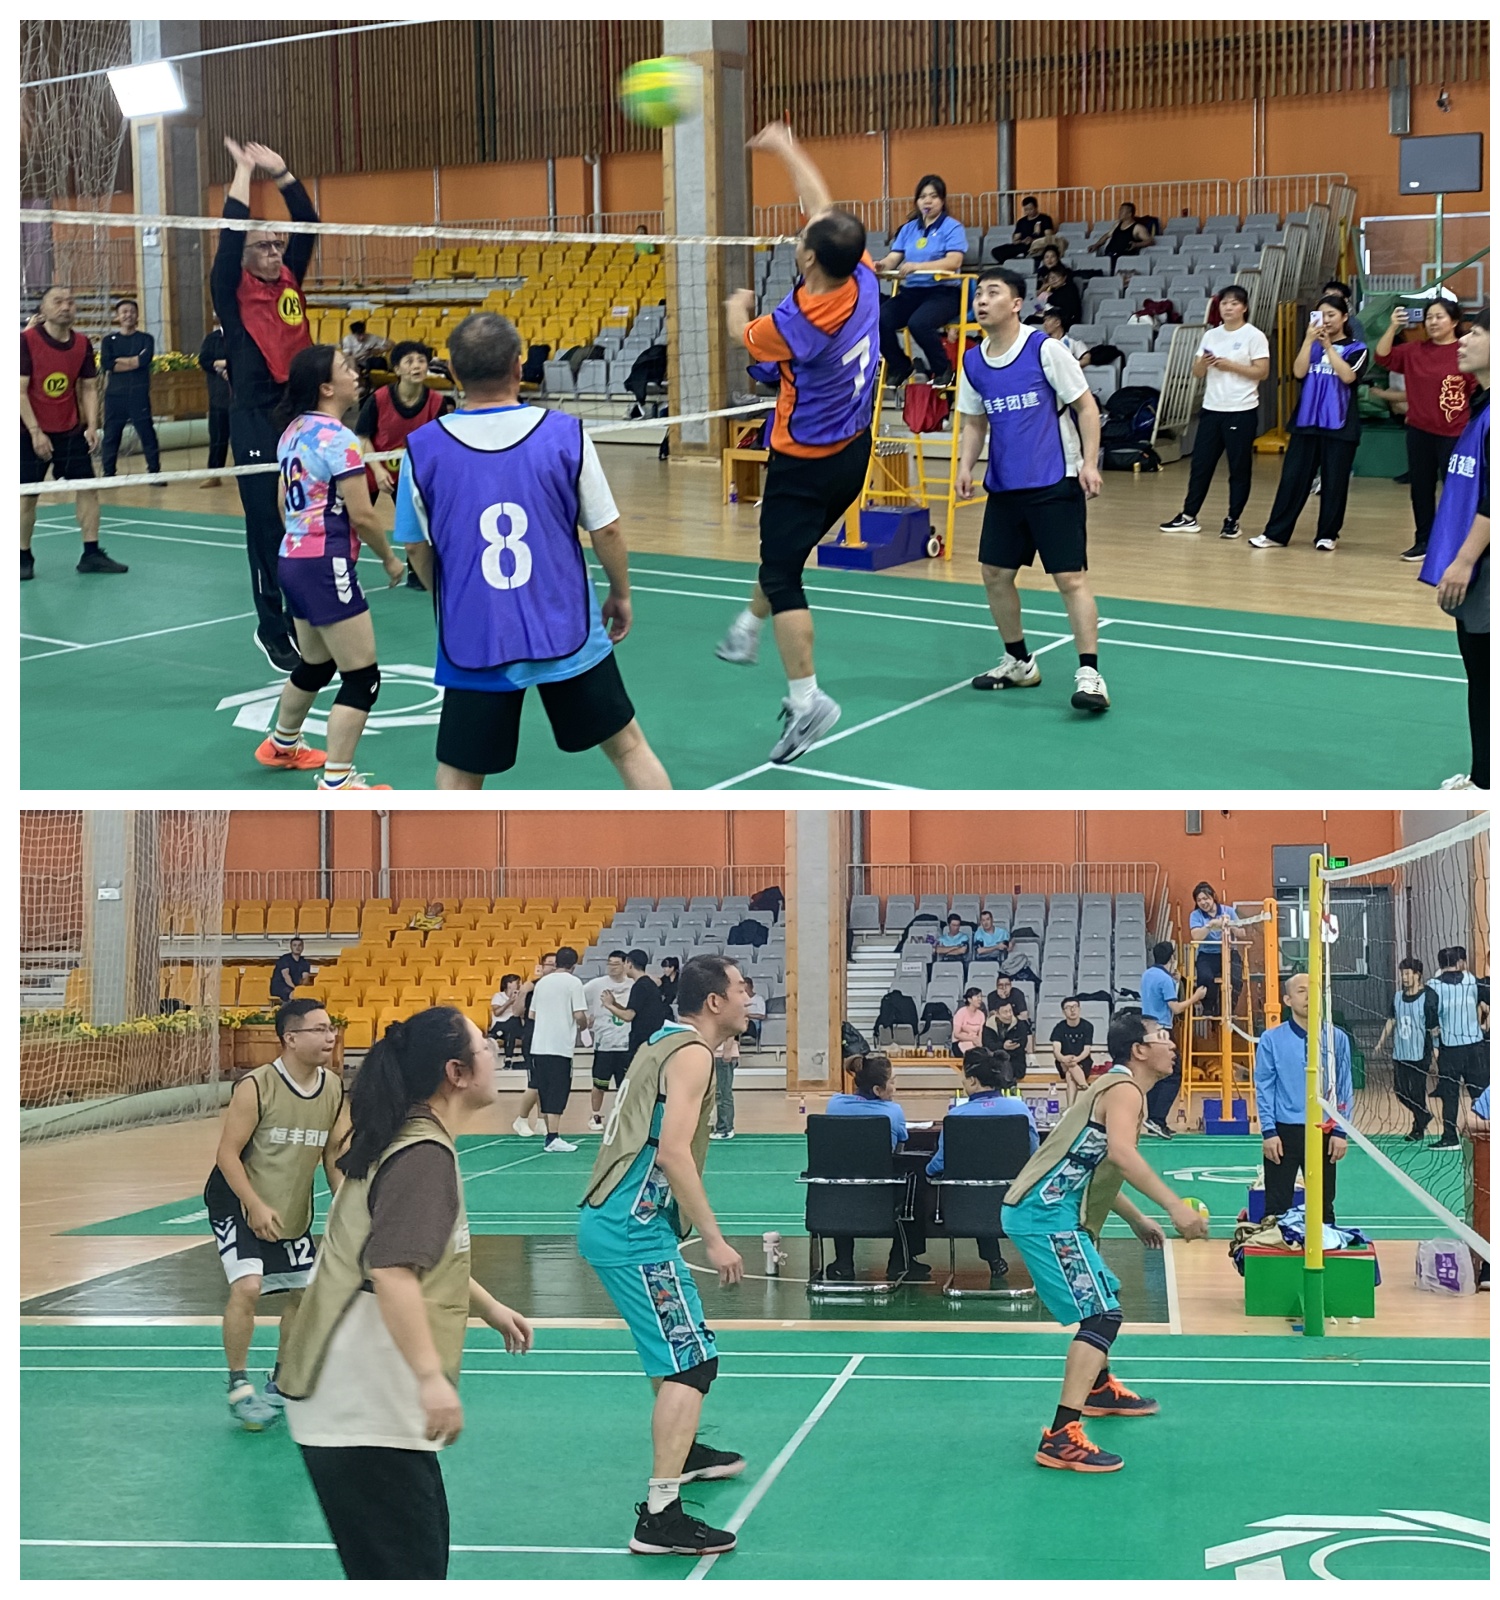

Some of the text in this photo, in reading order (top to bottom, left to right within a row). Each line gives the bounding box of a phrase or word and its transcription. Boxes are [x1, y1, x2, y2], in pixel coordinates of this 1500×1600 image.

[282, 295, 302, 316] 03
[841, 335, 870, 399] 7
[46, 378, 66, 392] 02
[479, 502, 533, 590] 8
[1400, 1015, 1412, 1040] 8
[282, 1236, 314, 1267] 12
